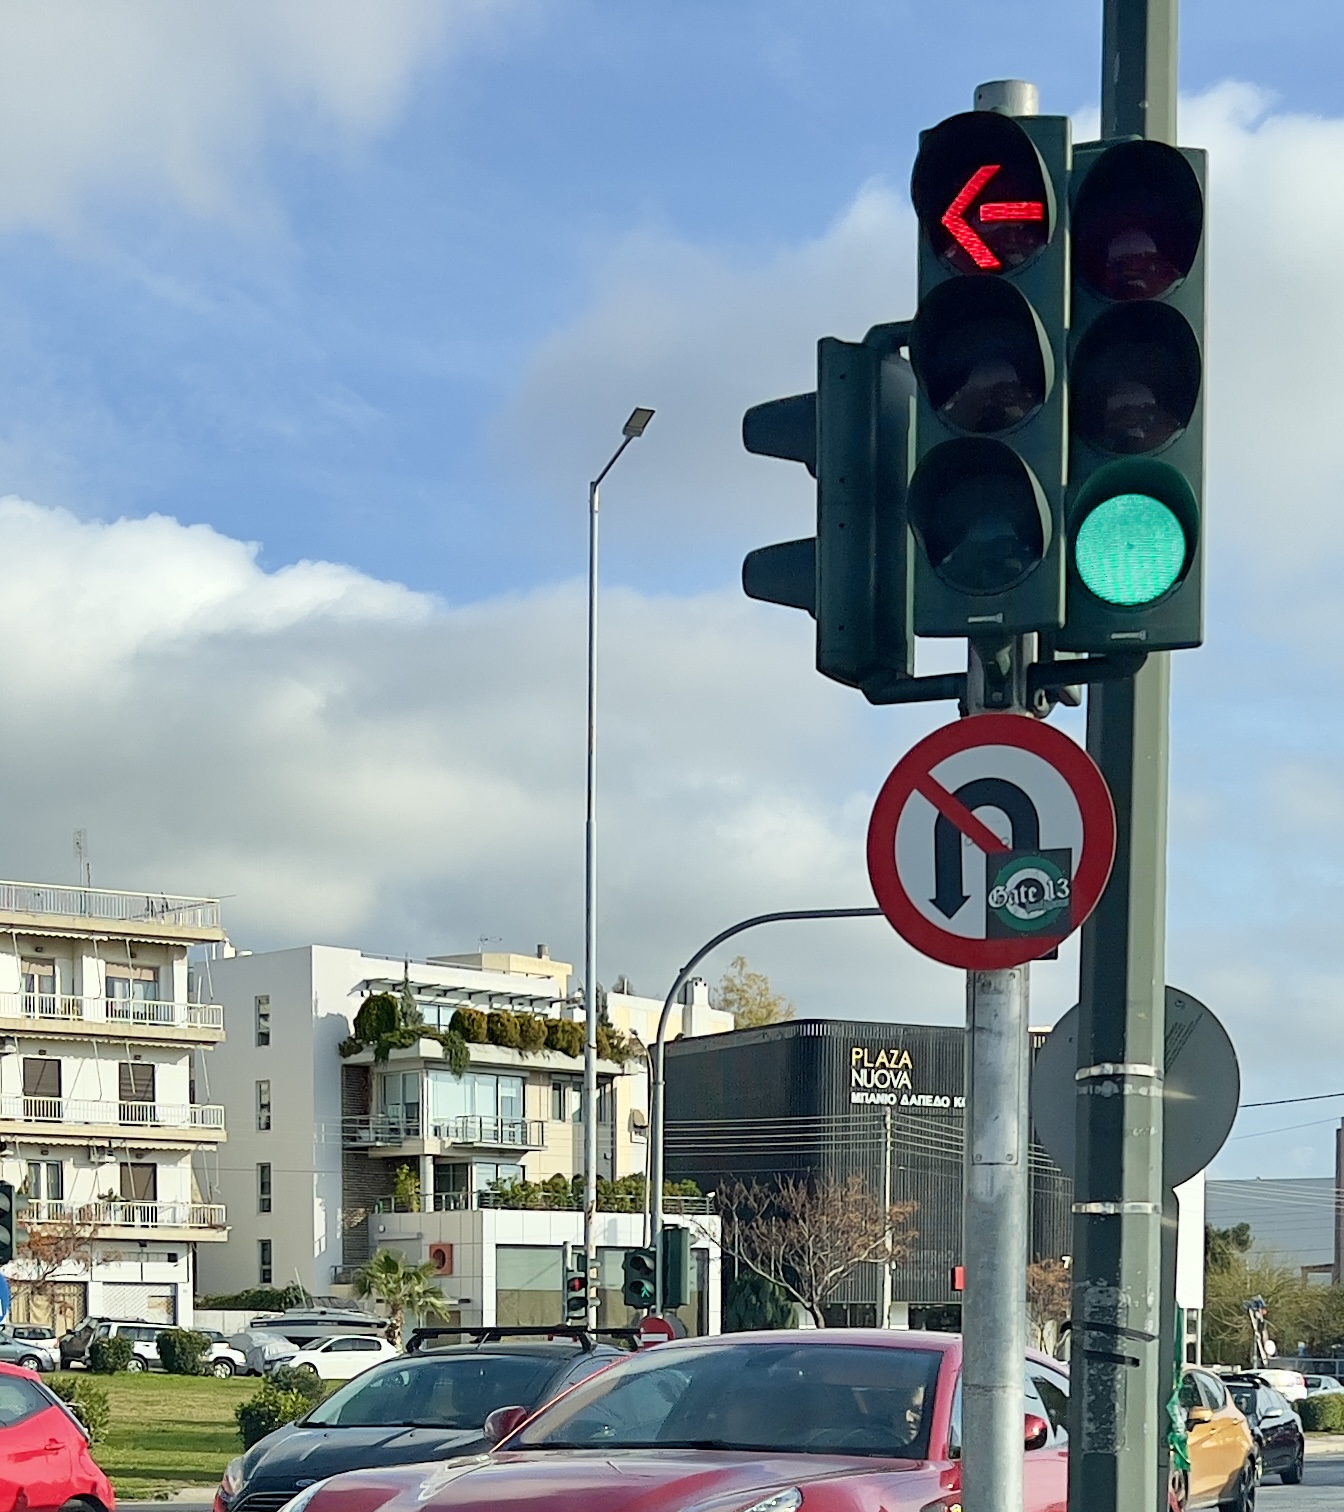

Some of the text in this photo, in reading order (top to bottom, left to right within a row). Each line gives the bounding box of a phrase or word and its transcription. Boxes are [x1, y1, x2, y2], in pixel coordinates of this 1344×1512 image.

[988, 878, 1070, 908] Gate 13
[851, 1047, 913, 1069] PLAZA
[851, 1068, 913, 1089] NUOVA
[851, 1091, 897, 1105] ΜΠΑΝΙΟ
[899, 1094, 951, 1108] ΔΑΠΕΔΟ
